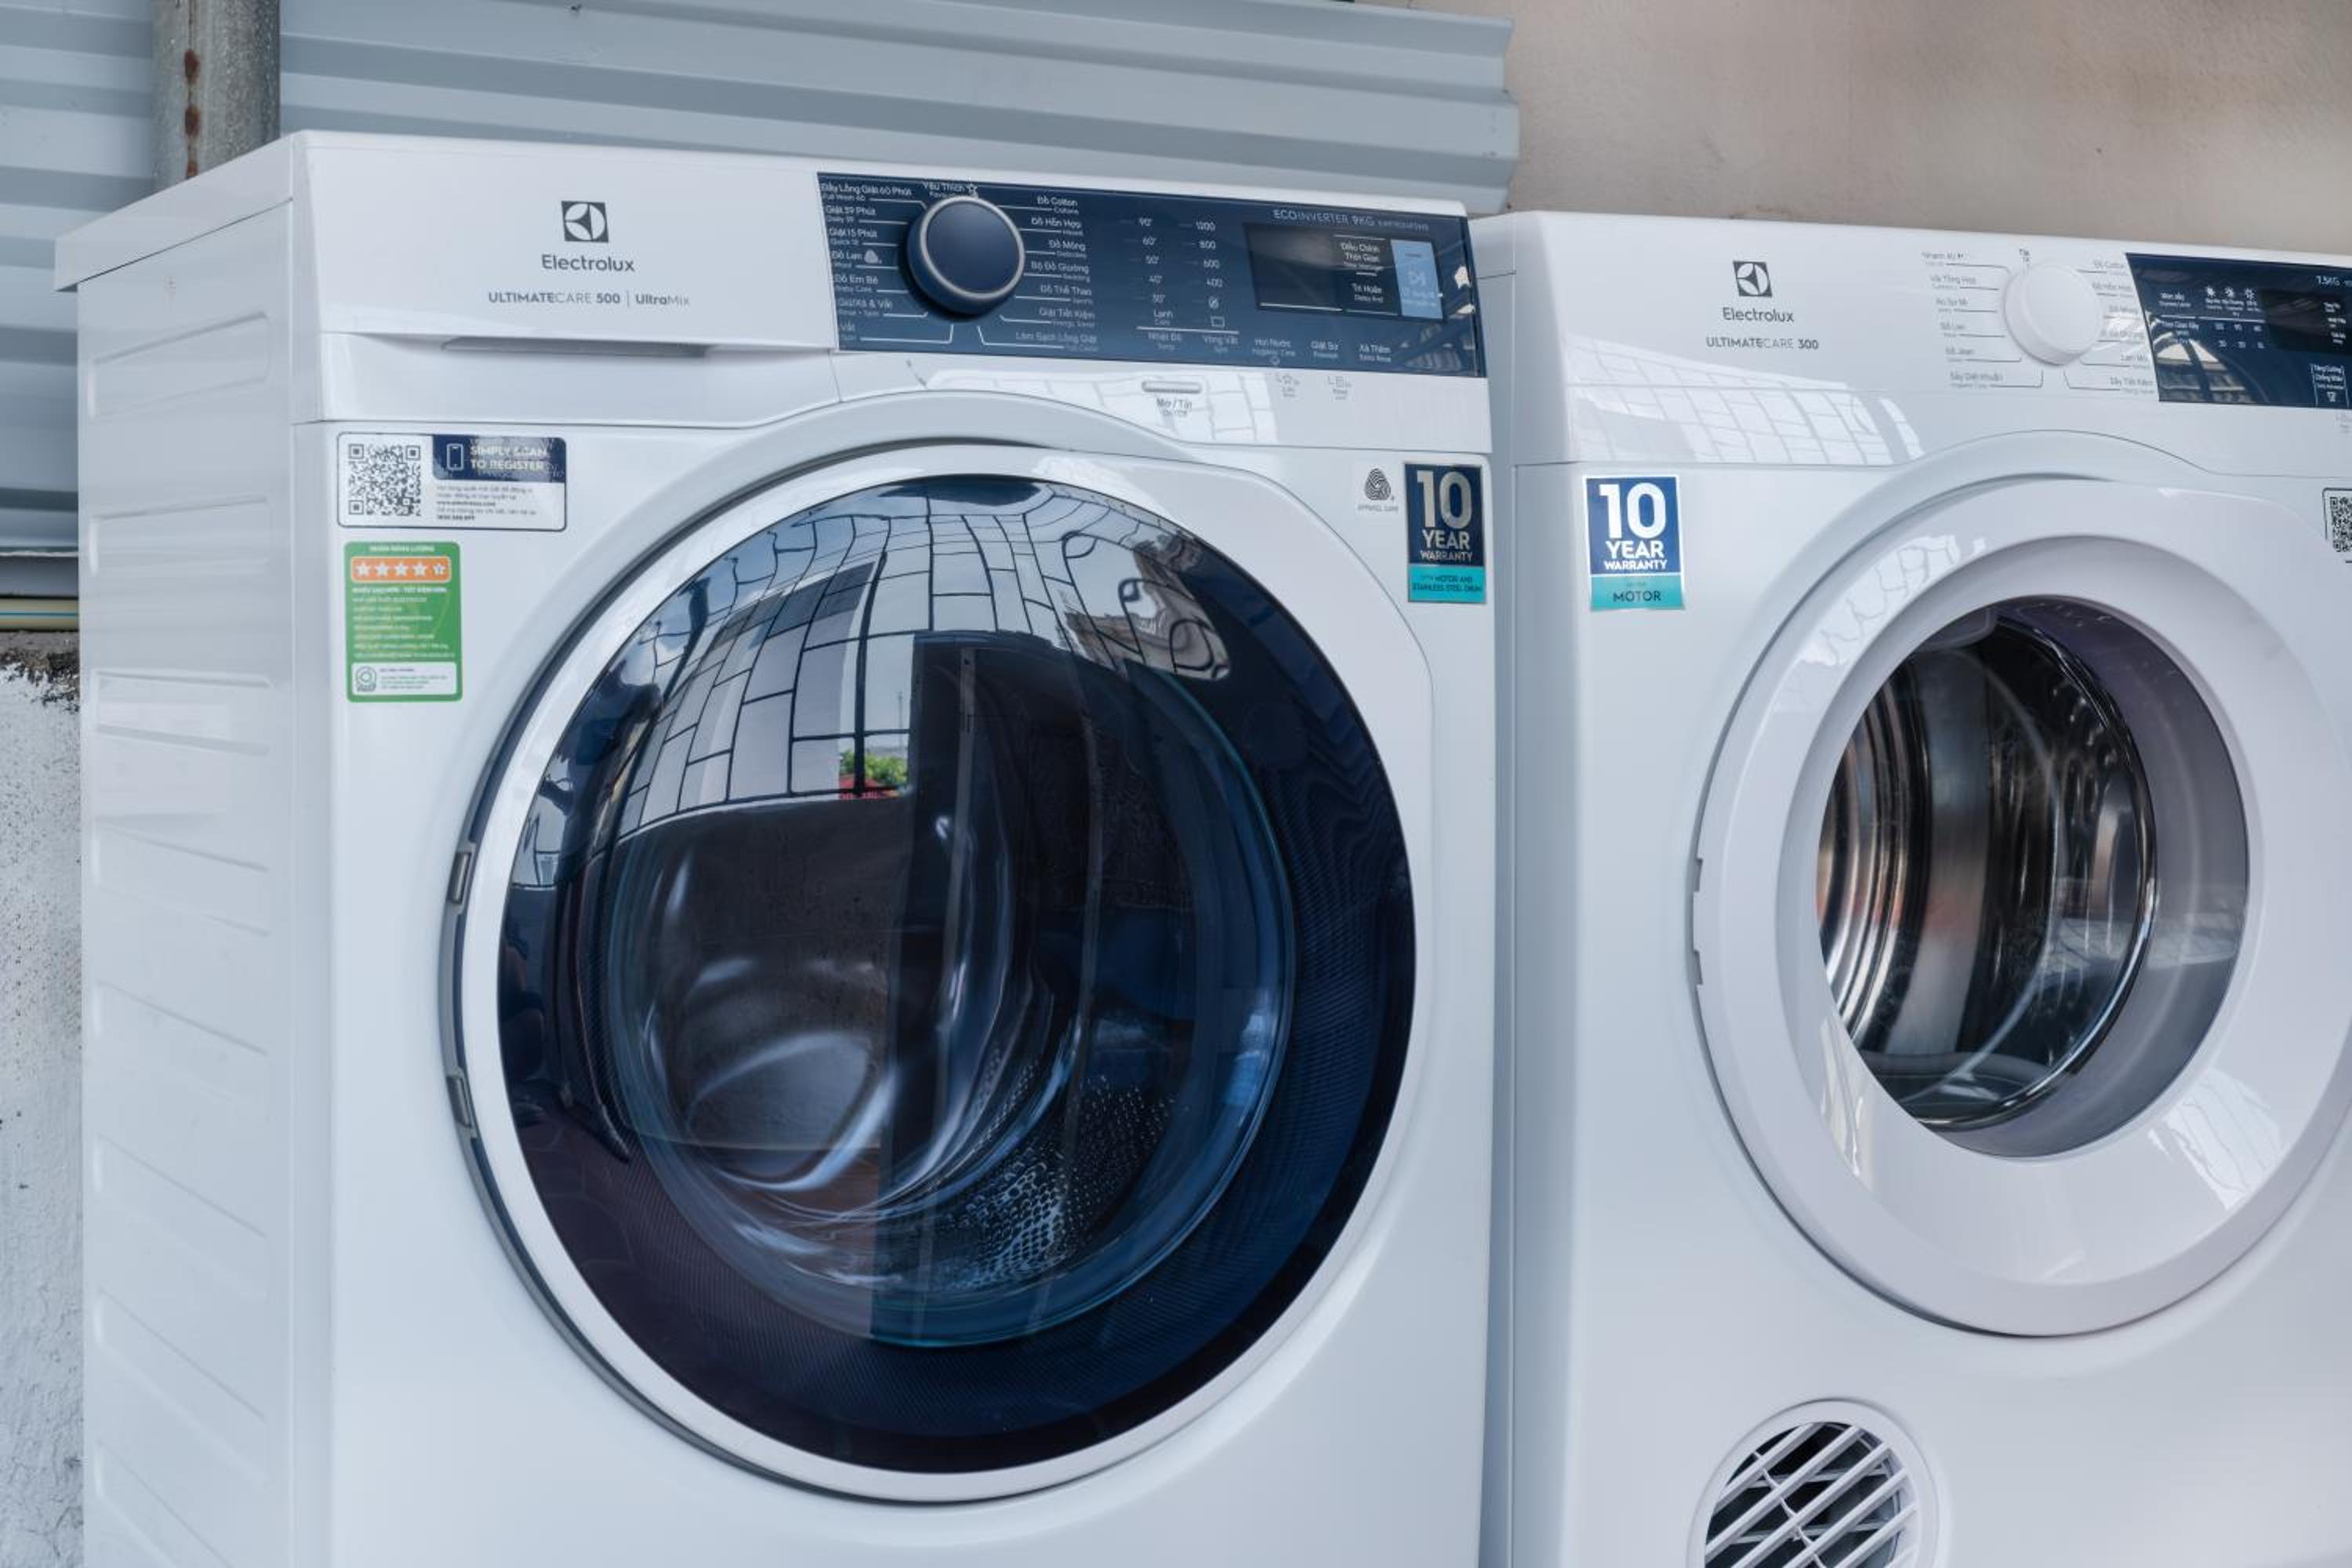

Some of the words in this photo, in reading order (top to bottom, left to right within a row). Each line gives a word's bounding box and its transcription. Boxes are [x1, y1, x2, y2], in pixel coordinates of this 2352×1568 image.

[542, 254, 635, 272] Electrolux
[488, 292, 591, 304] ULTIMATECARE
[596, 292, 621, 304] 500
[636, 293, 690, 307] UltraMix
[1722, 307, 1795, 323] Electrolux
[1706, 336, 1794, 349] ULTIMATECARE
[1798, 339, 1820, 350] 300
[470, 459, 486, 470] TO
[489, 459, 545, 470] REGISTER
[1417, 470, 1472, 529] 10
[1599, 482, 1667, 539] 10
[1421, 529, 1470, 550] YEAR
[1421, 550, 1473, 562] WARRANTY
[1606, 540, 1664, 559] YEAR
[1604, 559, 1668, 571] WARRANTY
[1613, 590, 1662, 603] MOTOR
